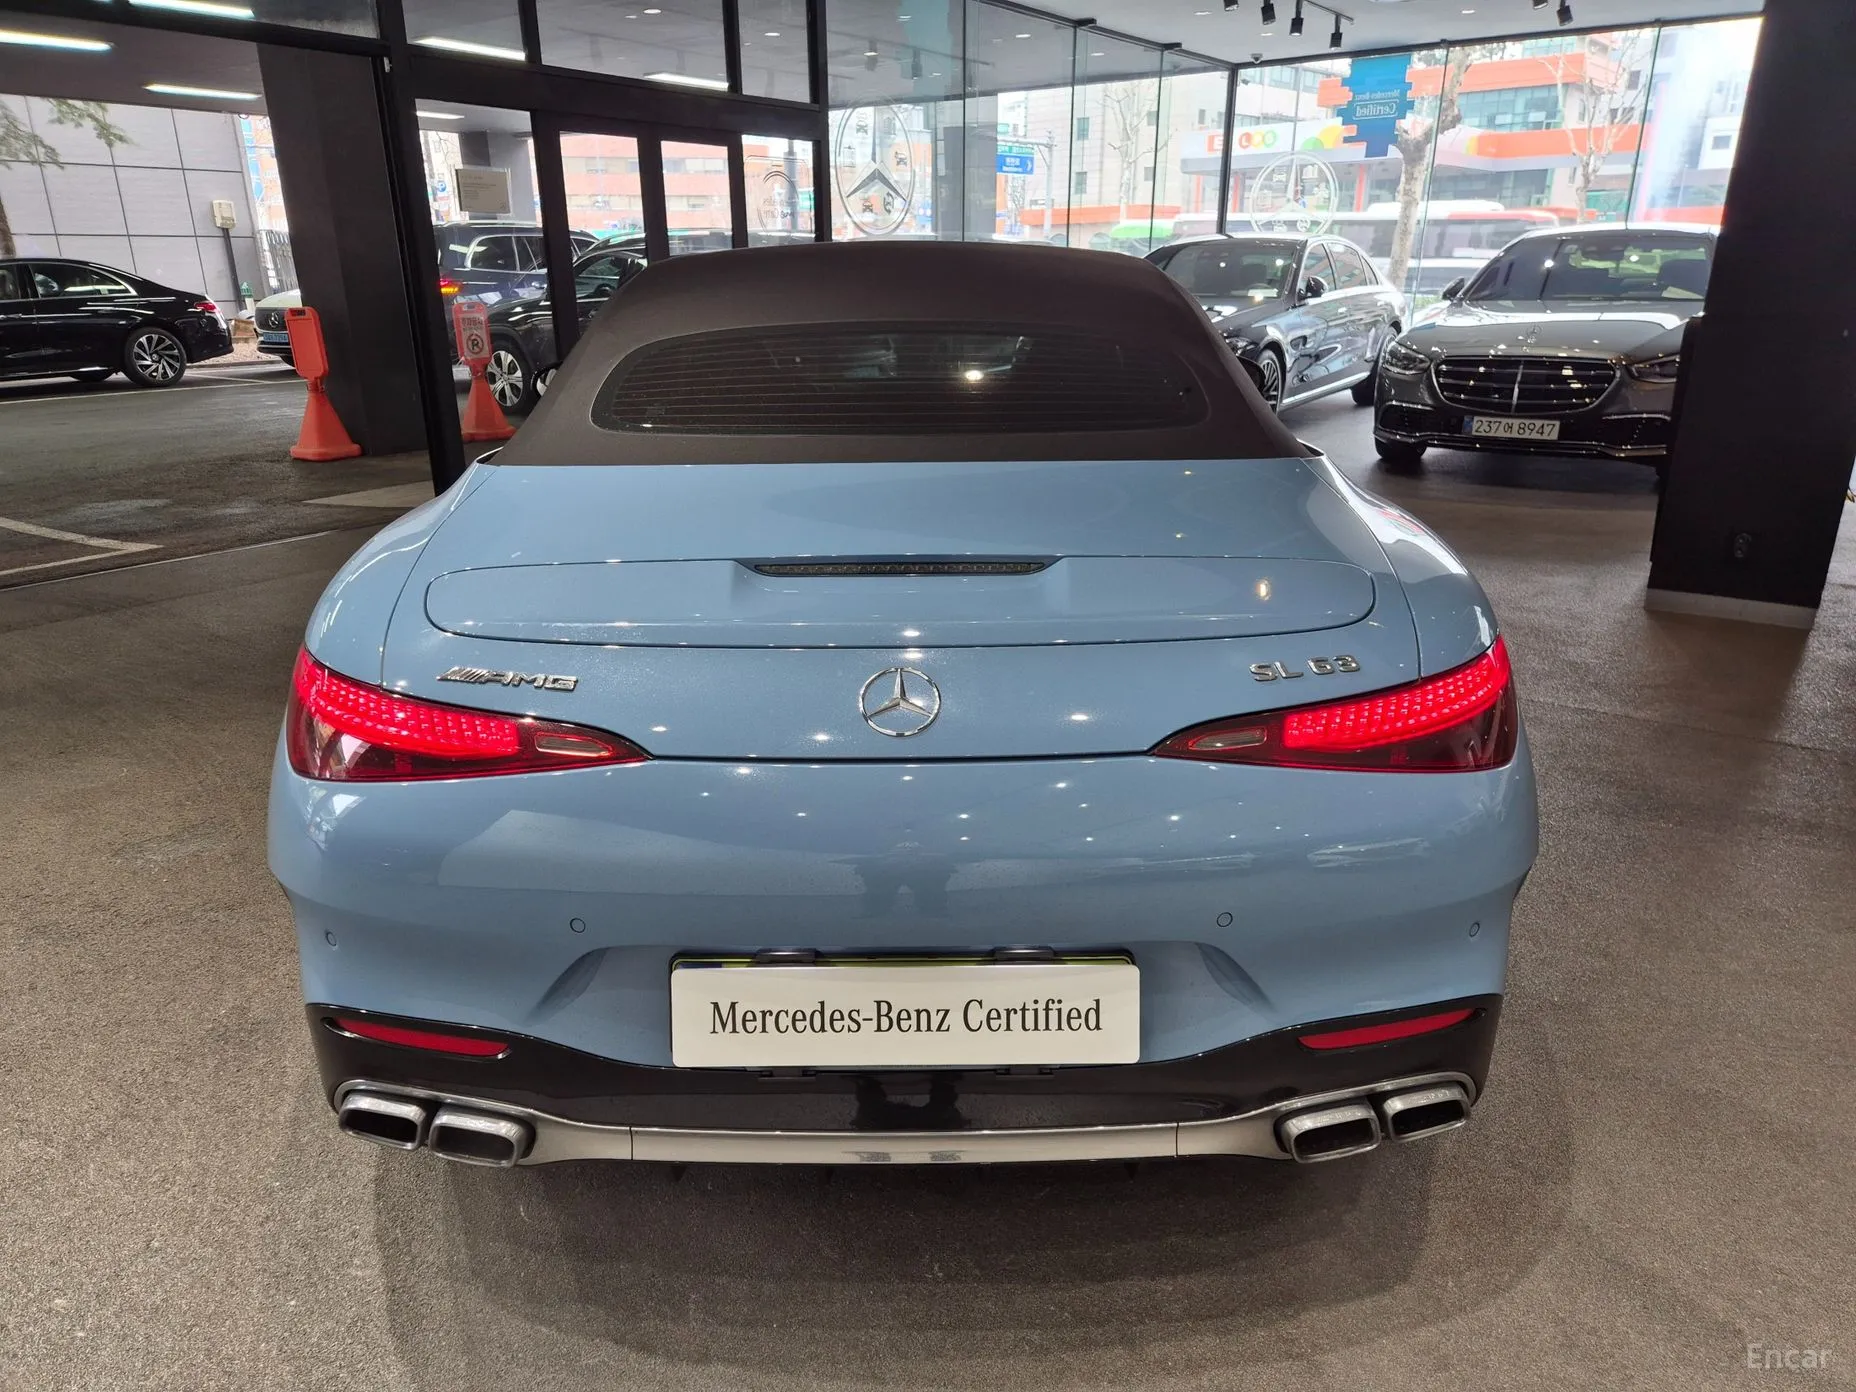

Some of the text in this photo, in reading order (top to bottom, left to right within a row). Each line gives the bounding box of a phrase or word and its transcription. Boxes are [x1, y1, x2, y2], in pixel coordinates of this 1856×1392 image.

[1517, 421, 1556, 437] 8947
[1249, 655, 1361, 681] SL 63
[479, 669, 579, 692] AMG
[710, 998, 1102, 1034] Mercedes-Benz Certified
